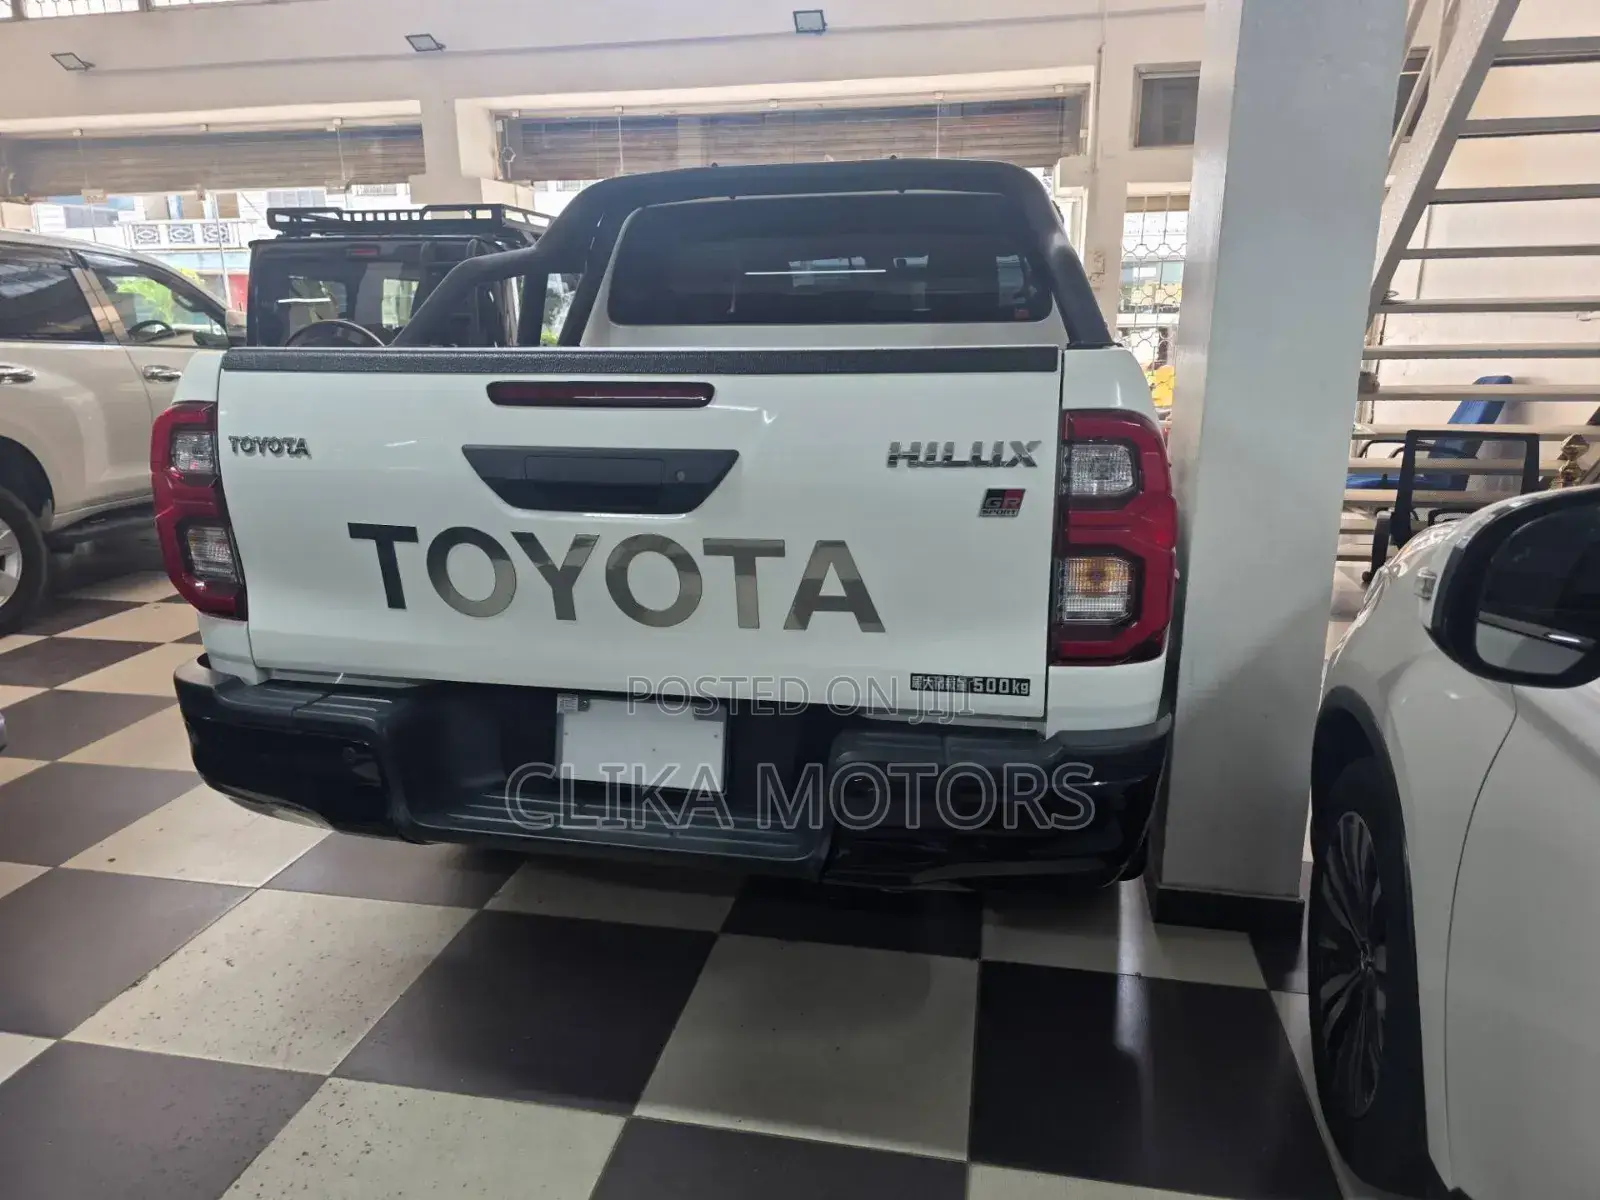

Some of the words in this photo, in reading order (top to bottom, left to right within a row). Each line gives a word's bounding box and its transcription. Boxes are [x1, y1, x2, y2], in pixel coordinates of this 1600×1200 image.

[228, 435, 312, 460] TOYOTA
[887, 440, 1042, 467] HILUX
[981, 508, 1018, 516] SPORT
[347, 522, 887, 633] TOYOTA
